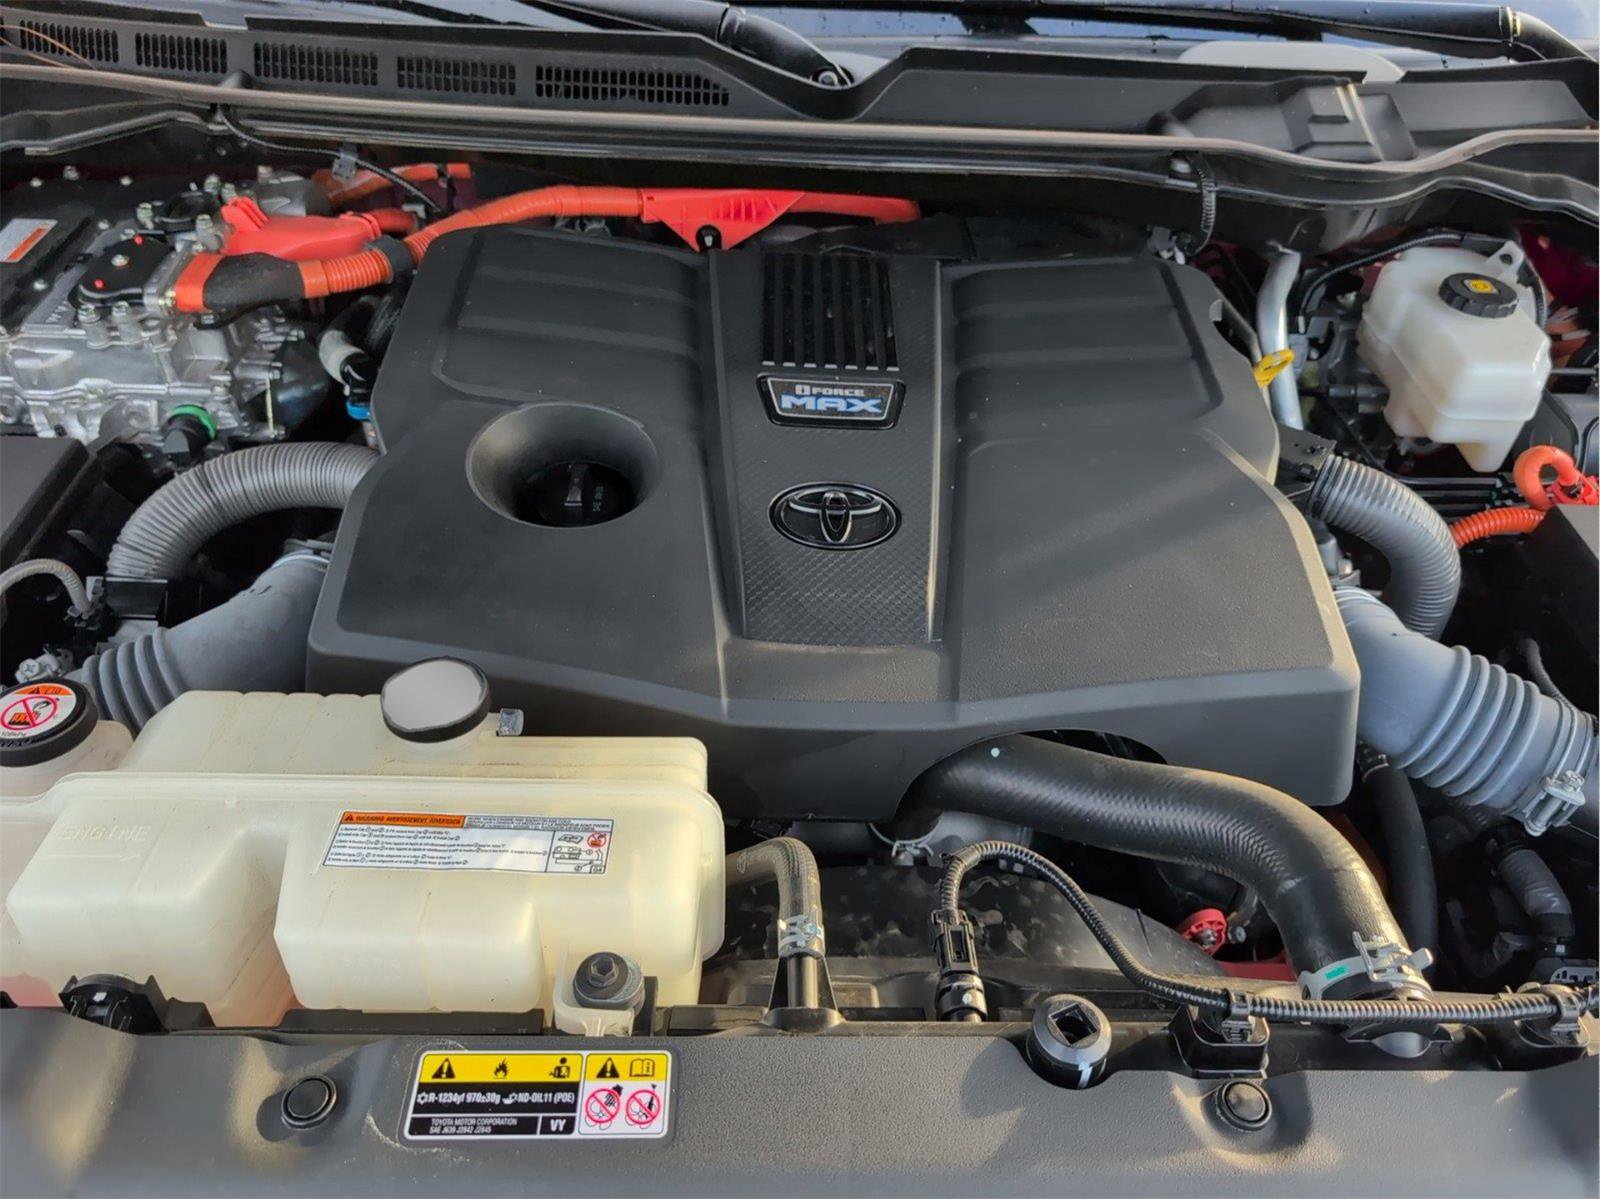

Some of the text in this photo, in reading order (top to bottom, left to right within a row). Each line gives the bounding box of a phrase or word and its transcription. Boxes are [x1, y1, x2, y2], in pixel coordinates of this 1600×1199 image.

[781, 394, 882, 413] MAX
[554, 1092, 575, 1104] (POE)
[431, 1118, 518, 1126] TOYOTA MOTOR CORPORATION
[550, 1118, 567, 1132] VY
[429, 1126, 442, 1134] SAE
